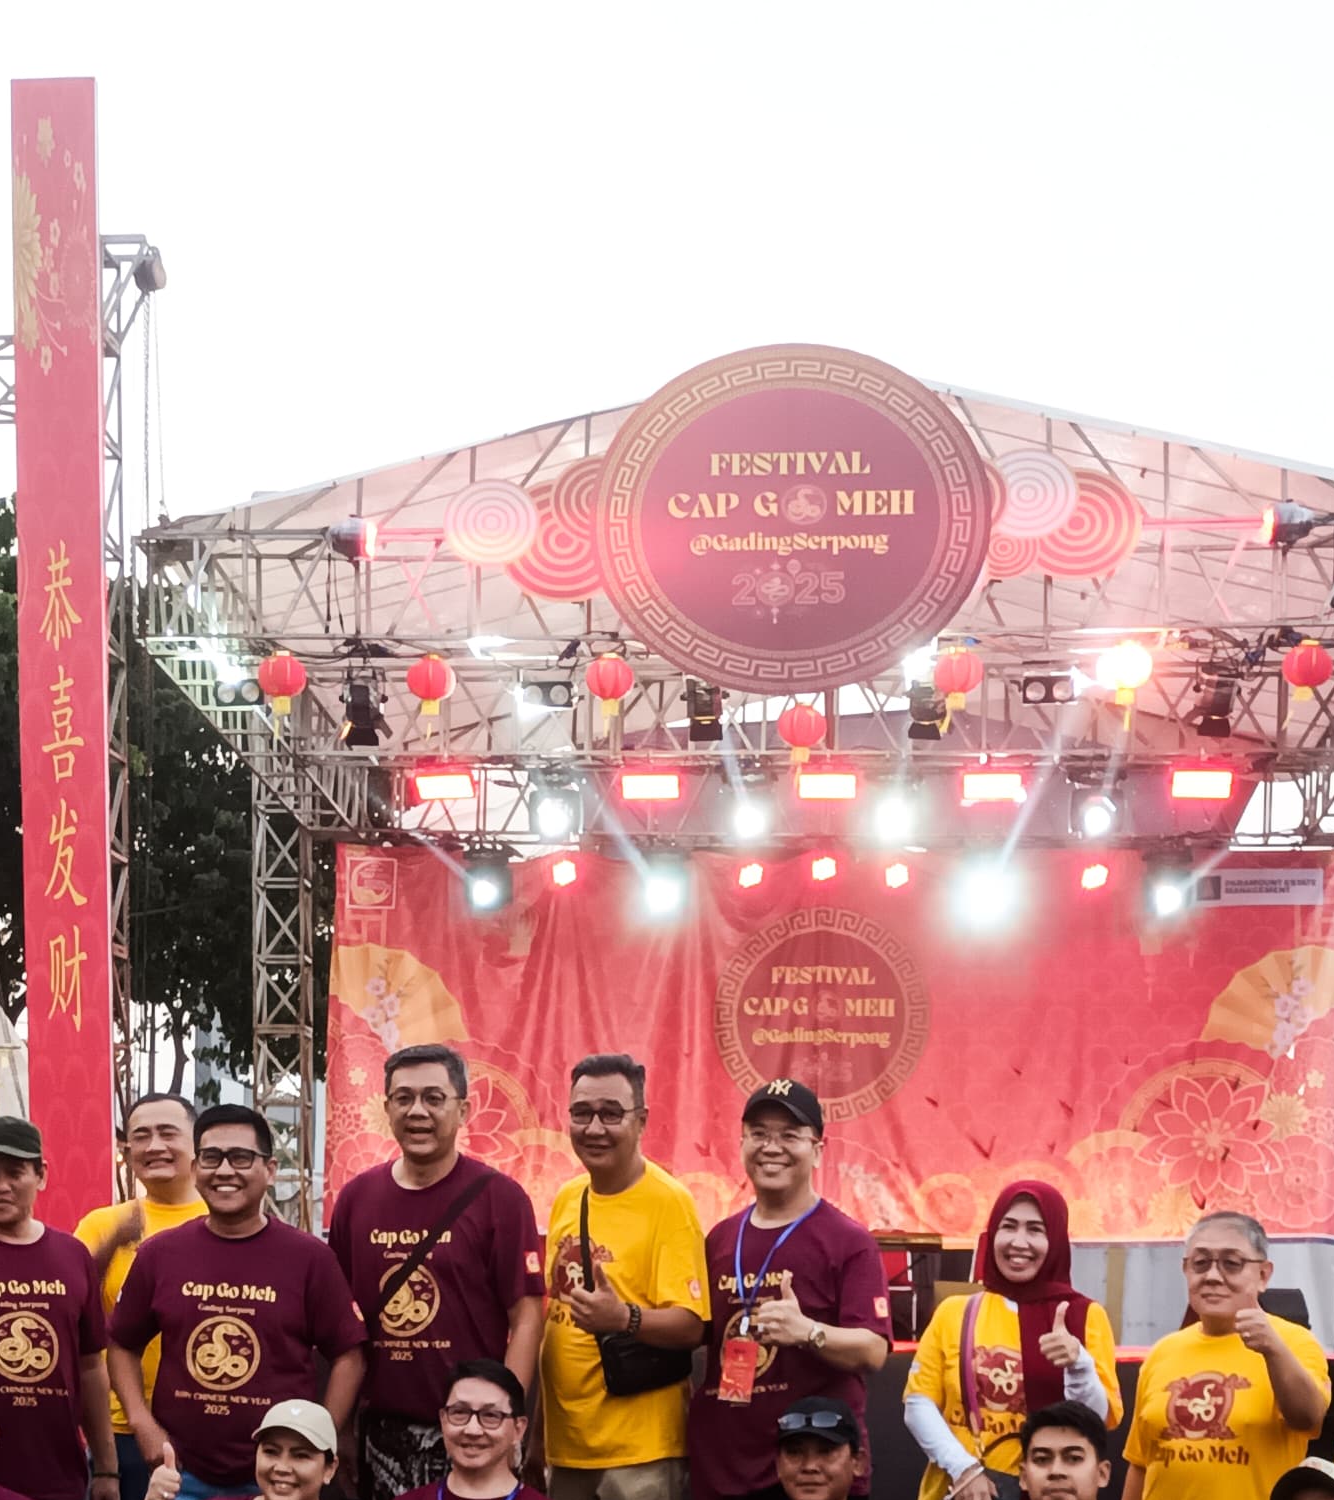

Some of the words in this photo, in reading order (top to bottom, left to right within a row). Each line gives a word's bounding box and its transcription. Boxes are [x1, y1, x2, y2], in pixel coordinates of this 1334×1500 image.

[710, 451, 870, 476] FESTIVAL
[667, 492, 740, 519] CAP
[836, 490, 915, 516] MEH
[690, 531, 889, 556] @GadingSerpong
[39, 539, 88, 1032] 恭喜发财
[771, 966, 875, 985] FESTIVAL
[743, 996, 789, 1016] CAP
[845, 998, 895, 1017] MEH
[752, 1028, 890, 1048] @GadingSerpong
[370, 1229, 398, 1247] Cap
[8, 1280, 30, 1295] Go
[34, 1279, 66, 1296] Meh
[182, 1282, 214, 1300] Cap
[217, 1282, 239, 1298] Go
[242, 1284, 276, 1302] Meh
[390, 1350, 414, 1361] 2025
[13, 1396, 37, 1407] 2025
[204, 1404, 230, 1415] 2025
[251, 1396, 271, 1405] YEAR
[1179, 1444, 1205, 1462] Go
[1208, 1446, 1250, 1466] Meh
